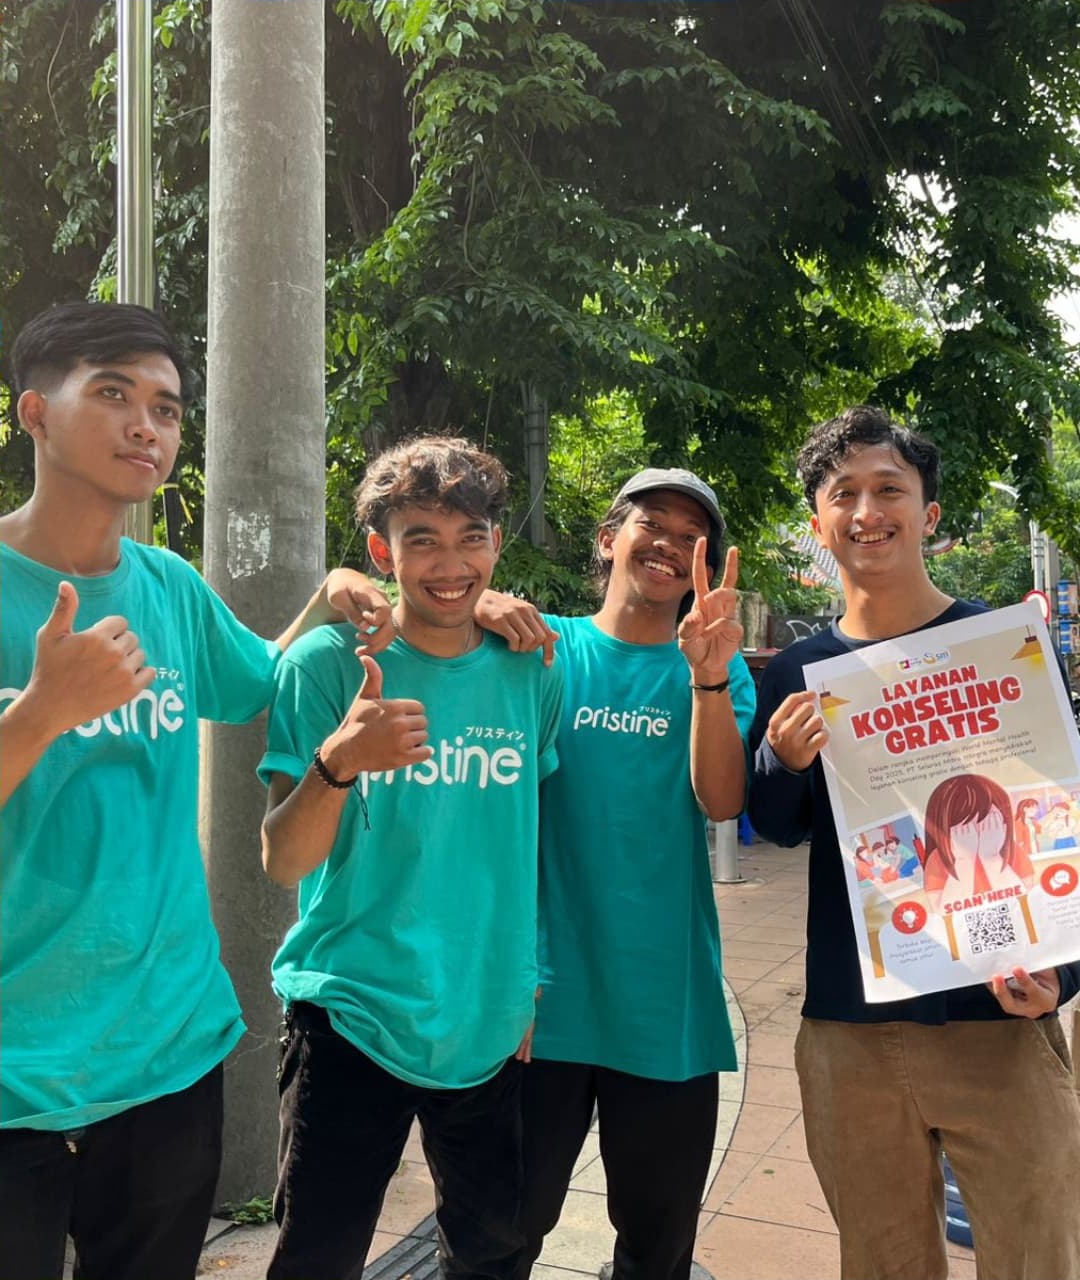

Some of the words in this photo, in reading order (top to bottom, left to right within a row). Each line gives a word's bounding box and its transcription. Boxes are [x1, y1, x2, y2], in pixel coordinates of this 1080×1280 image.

[882, 665, 977, 703] LAYANAN
[573, 706, 669, 737] pristine
[851, 676, 1021, 739] KONSELING
[465, 726, 525, 740] プリスティン
[885, 706, 1000, 754] GRATIS
[944, 895, 982, 913] SCAN
[987, 885, 1022, 903] HERE
